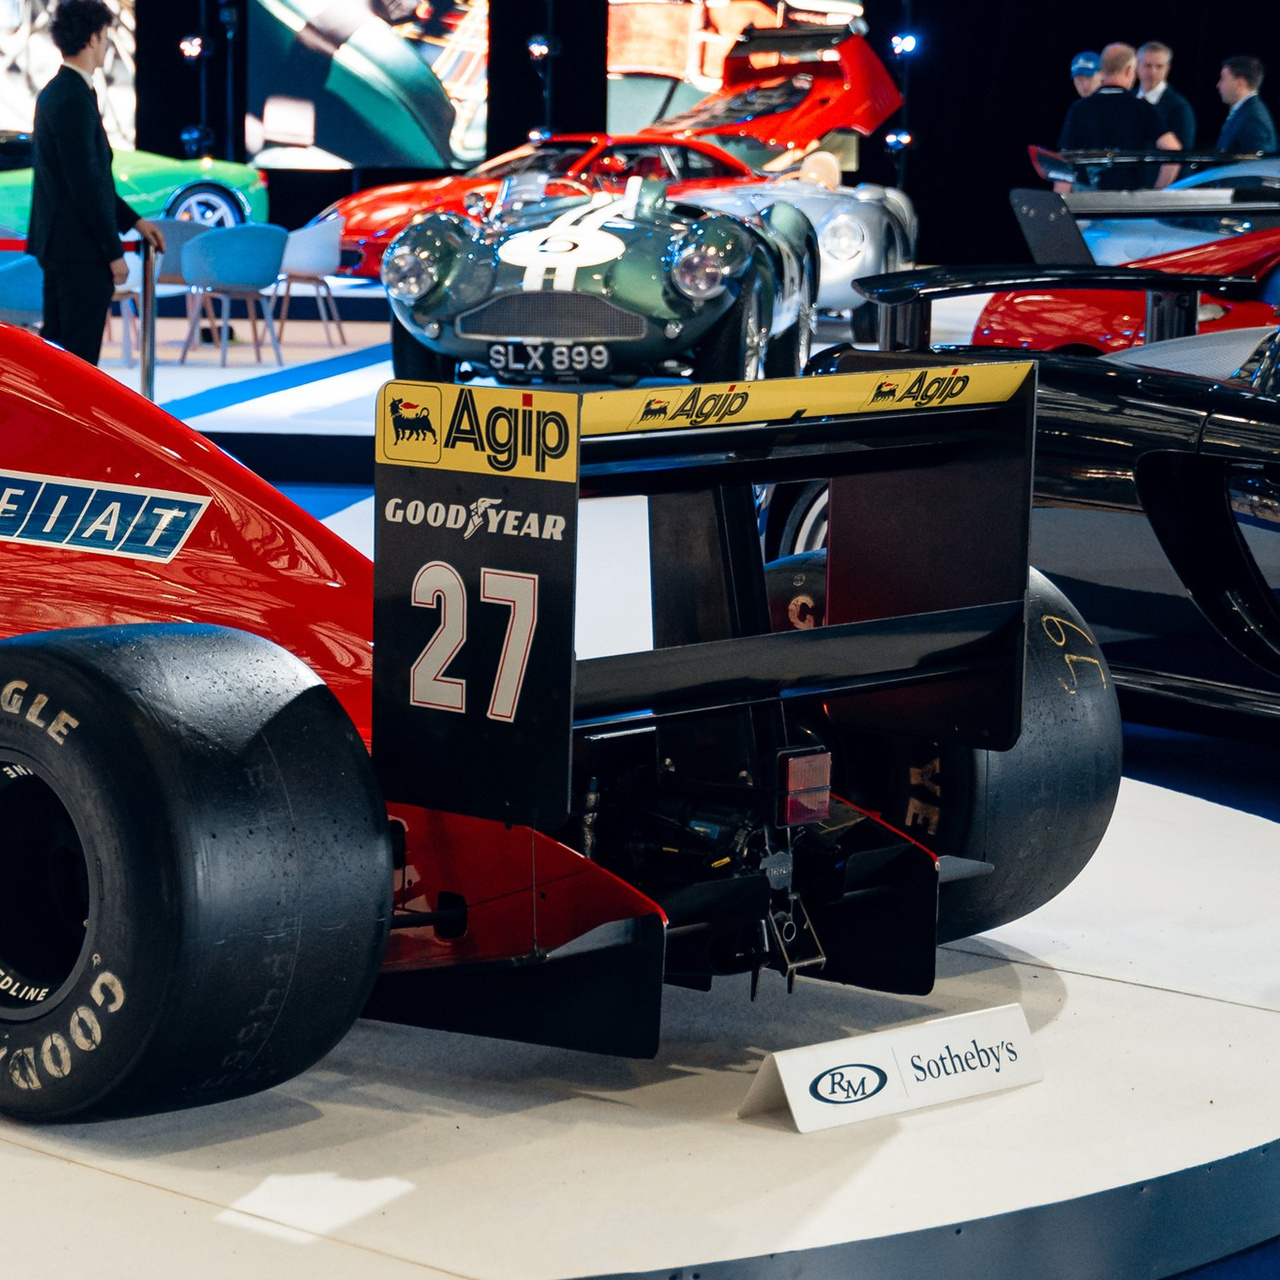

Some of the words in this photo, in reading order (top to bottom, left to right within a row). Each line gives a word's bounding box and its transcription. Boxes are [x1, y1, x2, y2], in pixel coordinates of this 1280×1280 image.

[489, 344, 545, 371] SLX
[551, 345, 609, 370] 899
[672, 385, 750, 425] Agip
[899, 368, 970, 408] Agip
[443, 388, 570, 472] Agip
[410, 561, 539, 723] 27
[910, 1038, 1019, 1083] Sotheby's
